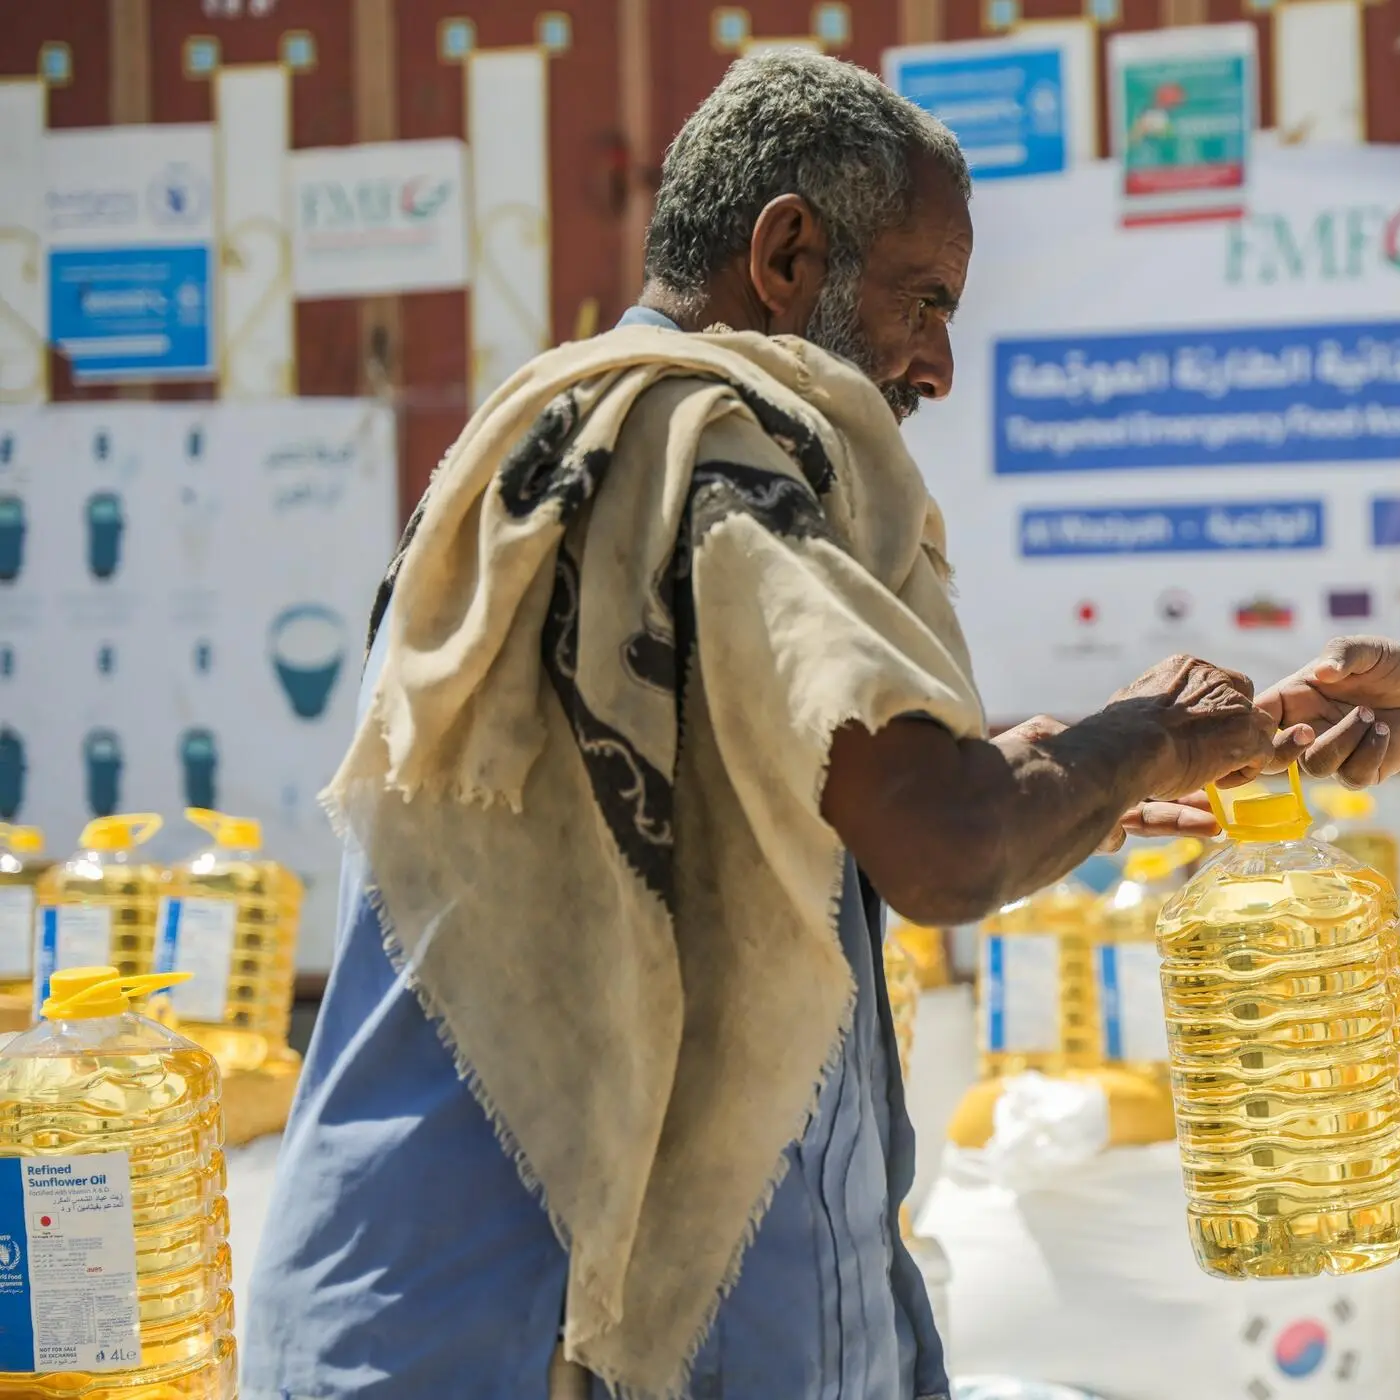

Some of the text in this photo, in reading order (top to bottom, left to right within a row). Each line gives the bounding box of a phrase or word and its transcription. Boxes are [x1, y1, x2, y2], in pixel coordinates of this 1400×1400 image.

[27, 1164, 72, 1175] Refined
[28, 1174, 107, 1187] Sunflower Oil
